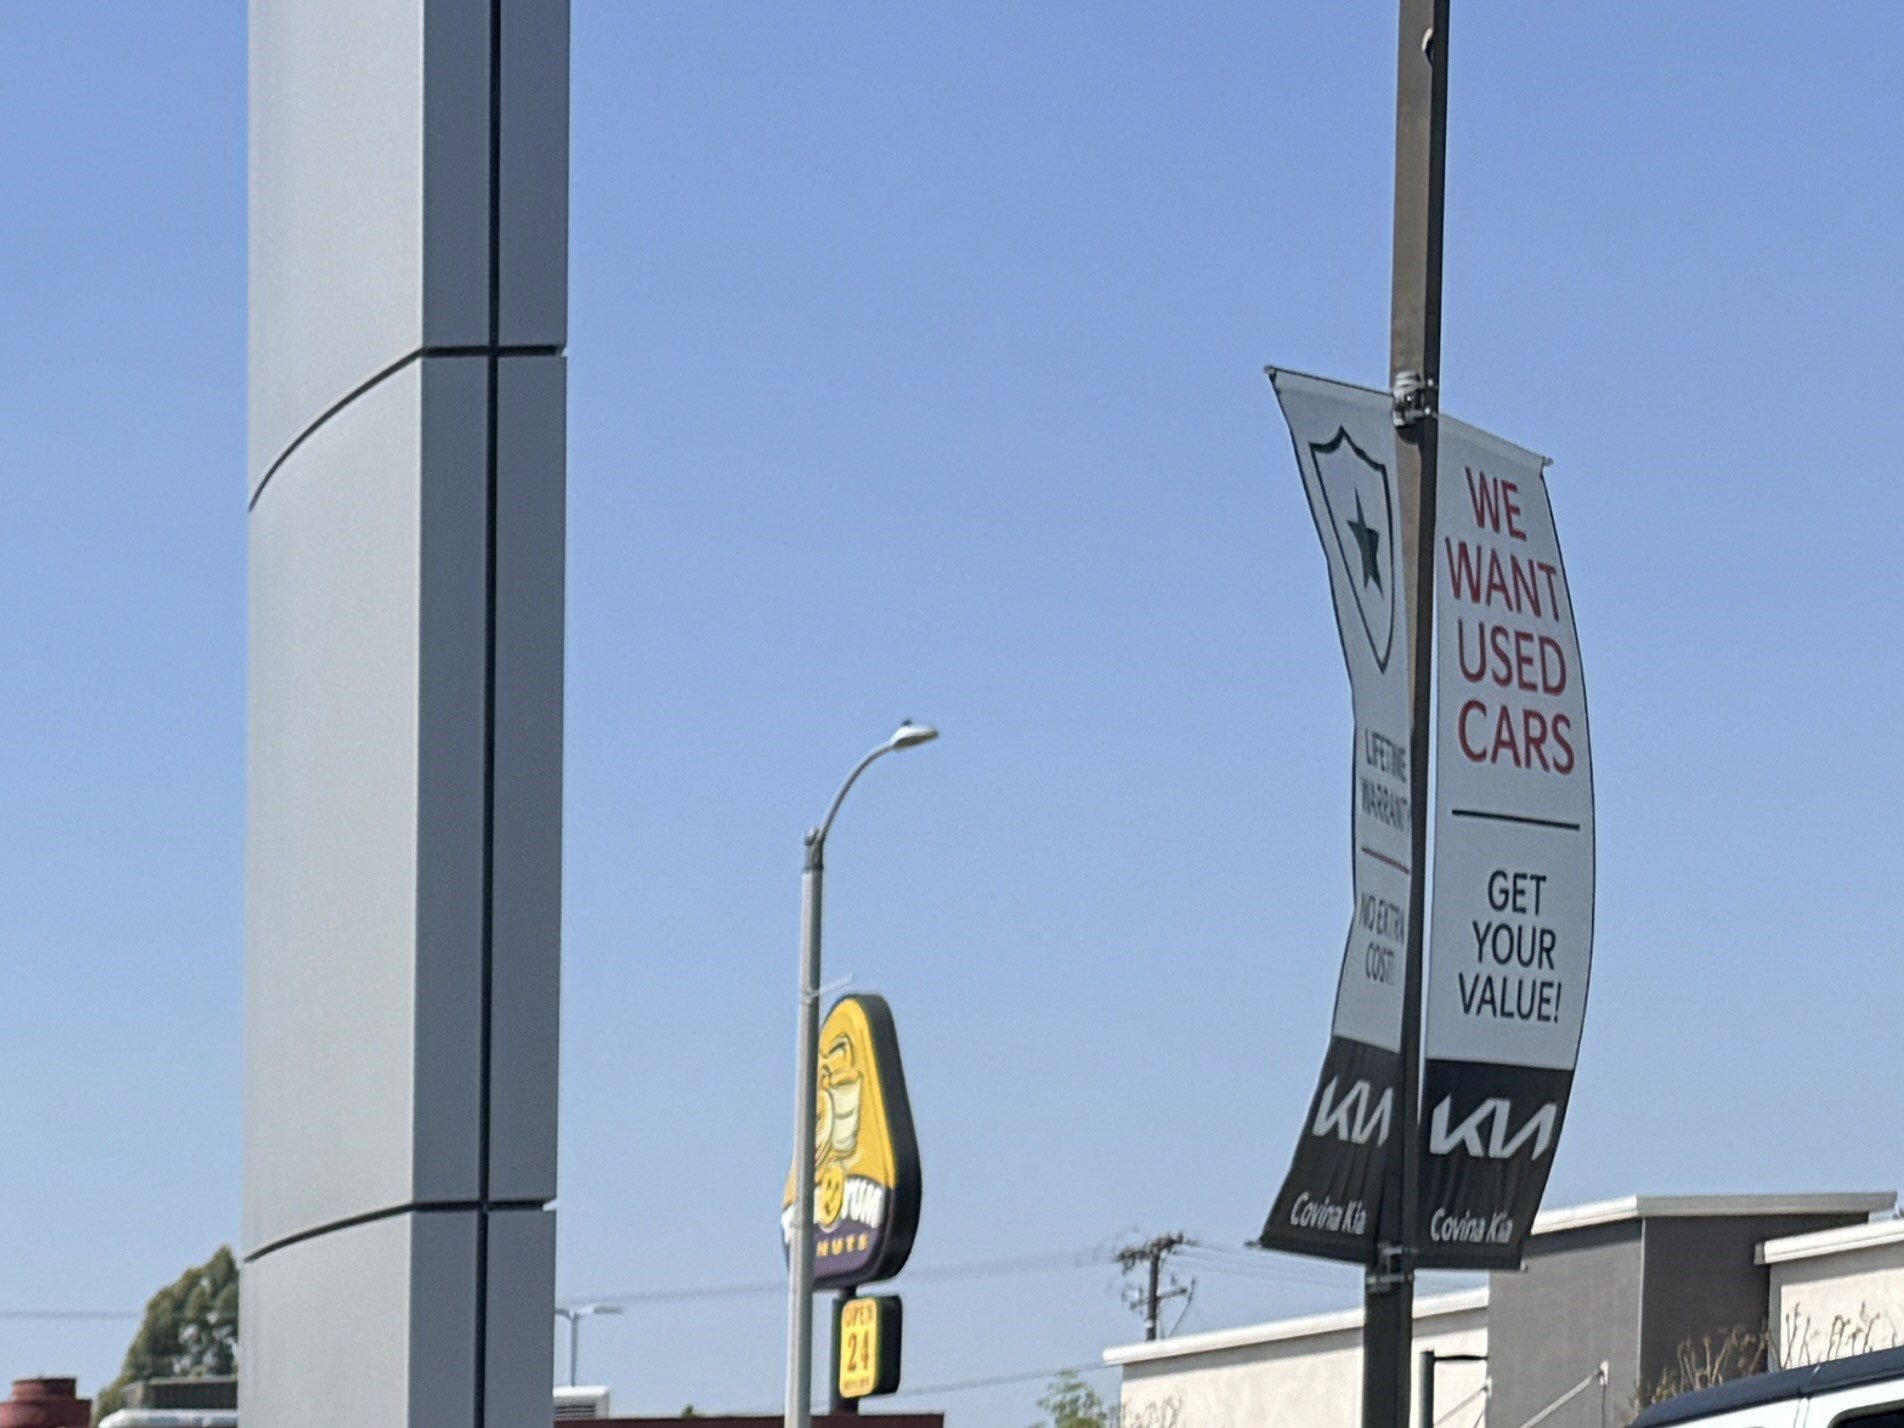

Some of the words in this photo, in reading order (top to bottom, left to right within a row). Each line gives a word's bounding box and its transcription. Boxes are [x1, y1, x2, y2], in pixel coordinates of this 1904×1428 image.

[1464, 466, 1527, 541] WE
[1445, 536, 1560, 622] WANT
[1457, 618, 1567, 697] USED
[1457, 699, 1575, 776] CARS
[1487, 870, 1548, 916] GET
[1472, 920, 1557, 970] YOUR
[1458, 972, 1563, 1024] VALUE!
[1290, 1191, 1342, 1232] Covina
[1342, 1200, 1367, 1236] Kia
[1430, 1208, 1484, 1243] Covina
[1486, 1211, 1514, 1244] Kia
[816, 1233, 869, 1257] NUTS
[847, 1330, 870, 1374] 24
